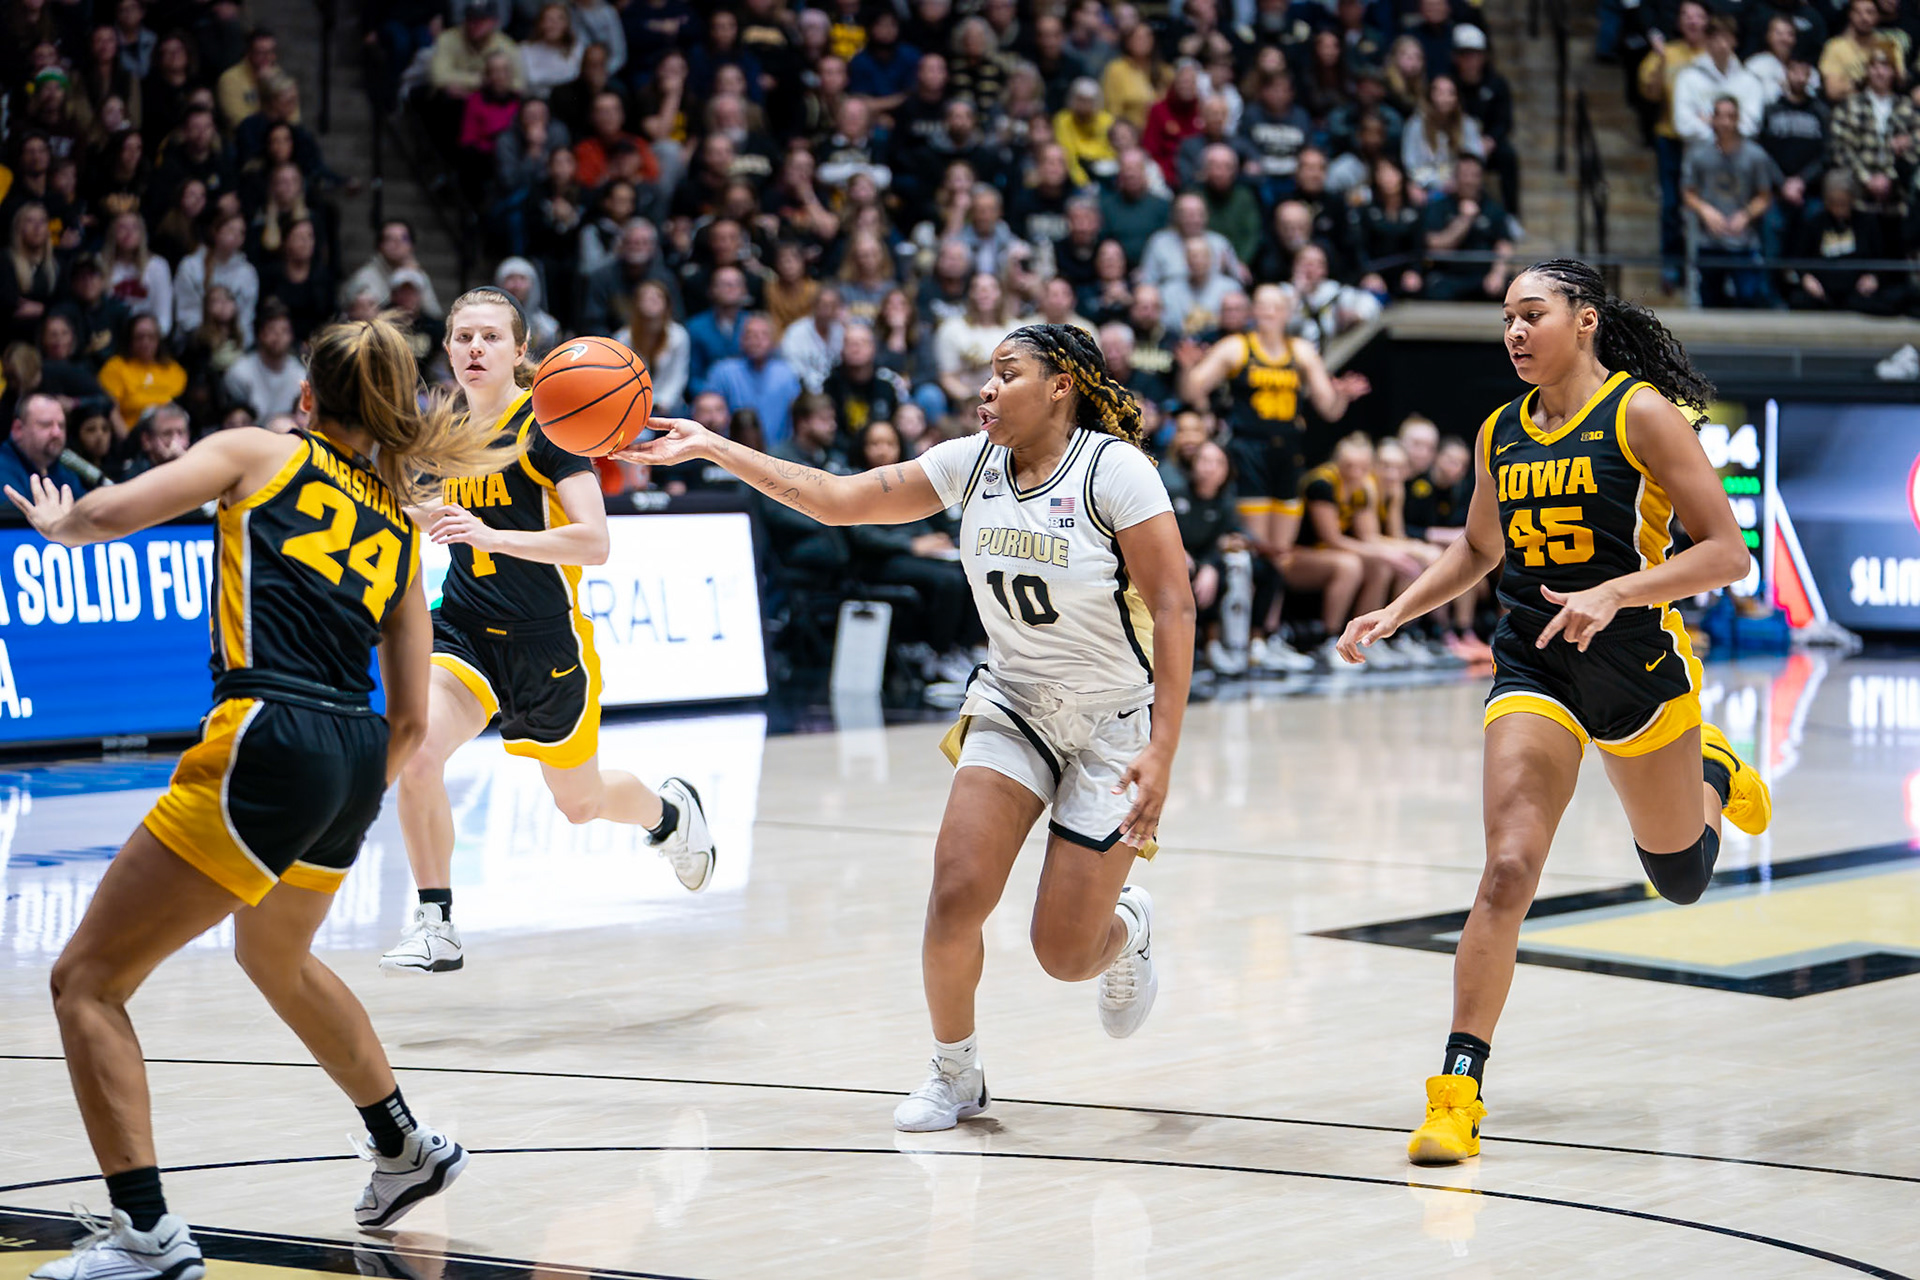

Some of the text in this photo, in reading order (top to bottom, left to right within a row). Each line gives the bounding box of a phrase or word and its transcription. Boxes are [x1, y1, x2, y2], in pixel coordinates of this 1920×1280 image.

[310, 438, 410, 534] MARSHALL
[1498, 456, 1598, 502] IOWA
[281, 480, 402, 623] 24
[976, 527, 1069, 569] PURDUE
[1508, 506, 1595, 567] 45
[13, 541, 142, 626] SOLID
[986, 569, 1060, 626] 10
